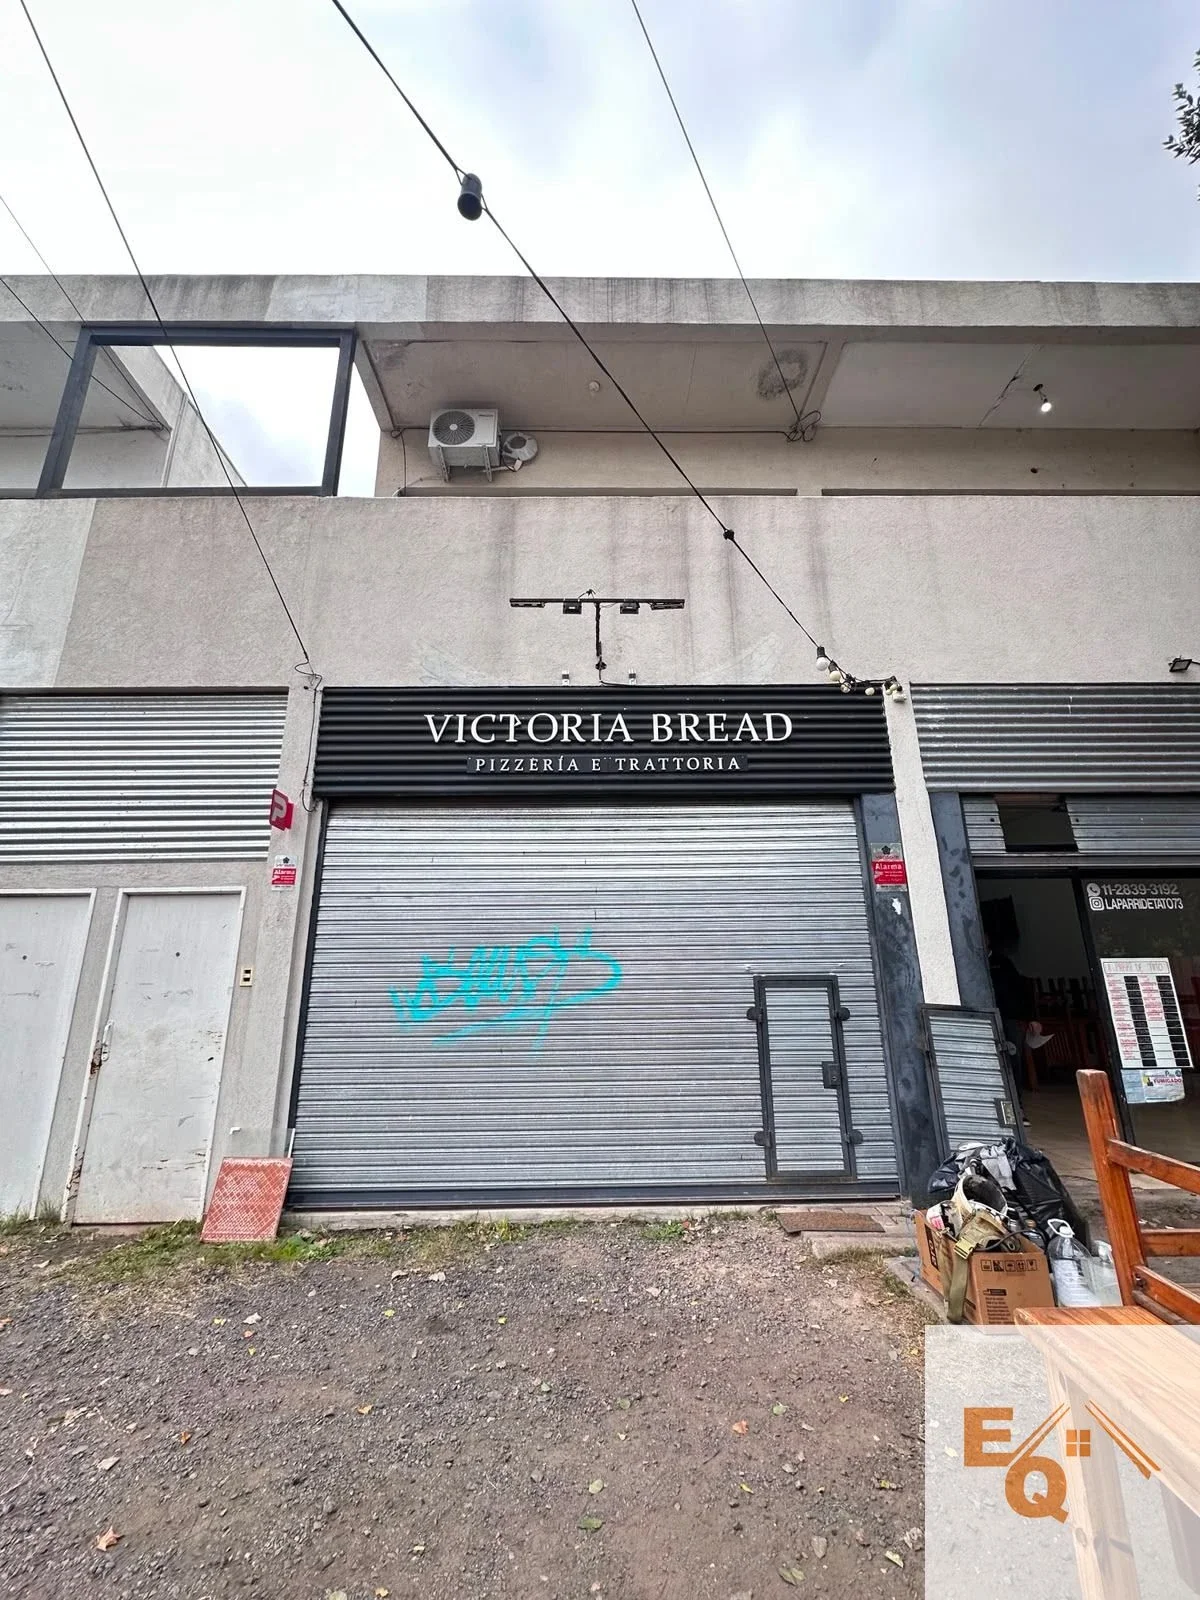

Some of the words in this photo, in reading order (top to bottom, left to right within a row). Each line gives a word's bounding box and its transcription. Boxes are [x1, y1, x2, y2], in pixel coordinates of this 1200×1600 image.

[424, 713, 634, 743] VICTORIA
[651, 712, 793, 742] BREAD
[475, 755, 579, 771] PIZZERÍA
[592, 758, 601, 771] E
[615, 757, 740, 771] TRATTORIA
[1101, 884, 1180, 896] 11-2839-3192
[1105, 898, 1184, 910] LAPARRIDETATO73
